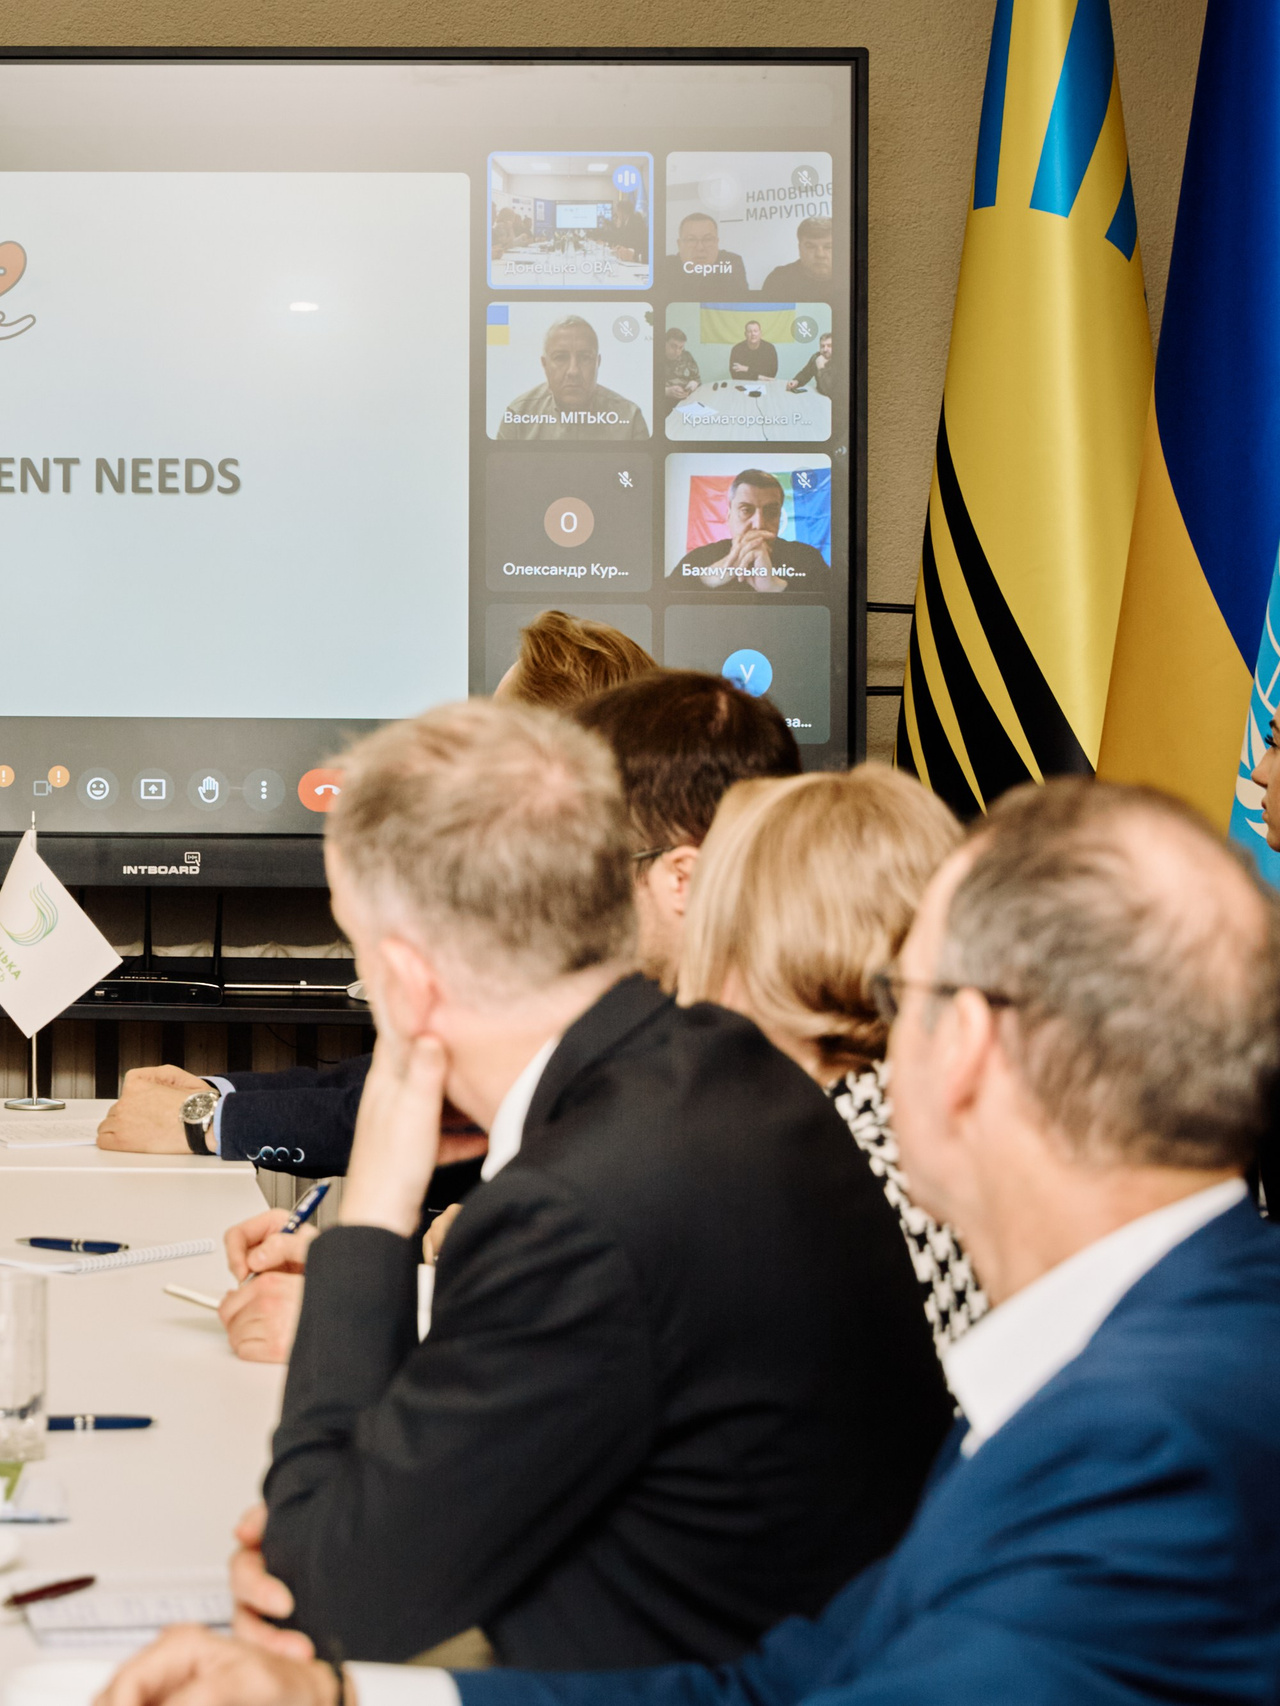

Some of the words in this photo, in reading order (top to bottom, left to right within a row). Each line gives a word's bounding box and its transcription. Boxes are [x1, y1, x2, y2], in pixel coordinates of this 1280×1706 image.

[504, 261, 577, 275] Донецька
[683, 260, 733, 276] Сергій
[504, 411, 557, 424] Василь
[683, 413, 789, 429] Краматорська
[95, 457, 242, 494] NEEDS
[503, 563, 587, 579] Олександр
[682, 564, 767, 580] Бахмутська
[122, 865, 200, 875] INTBOARD
